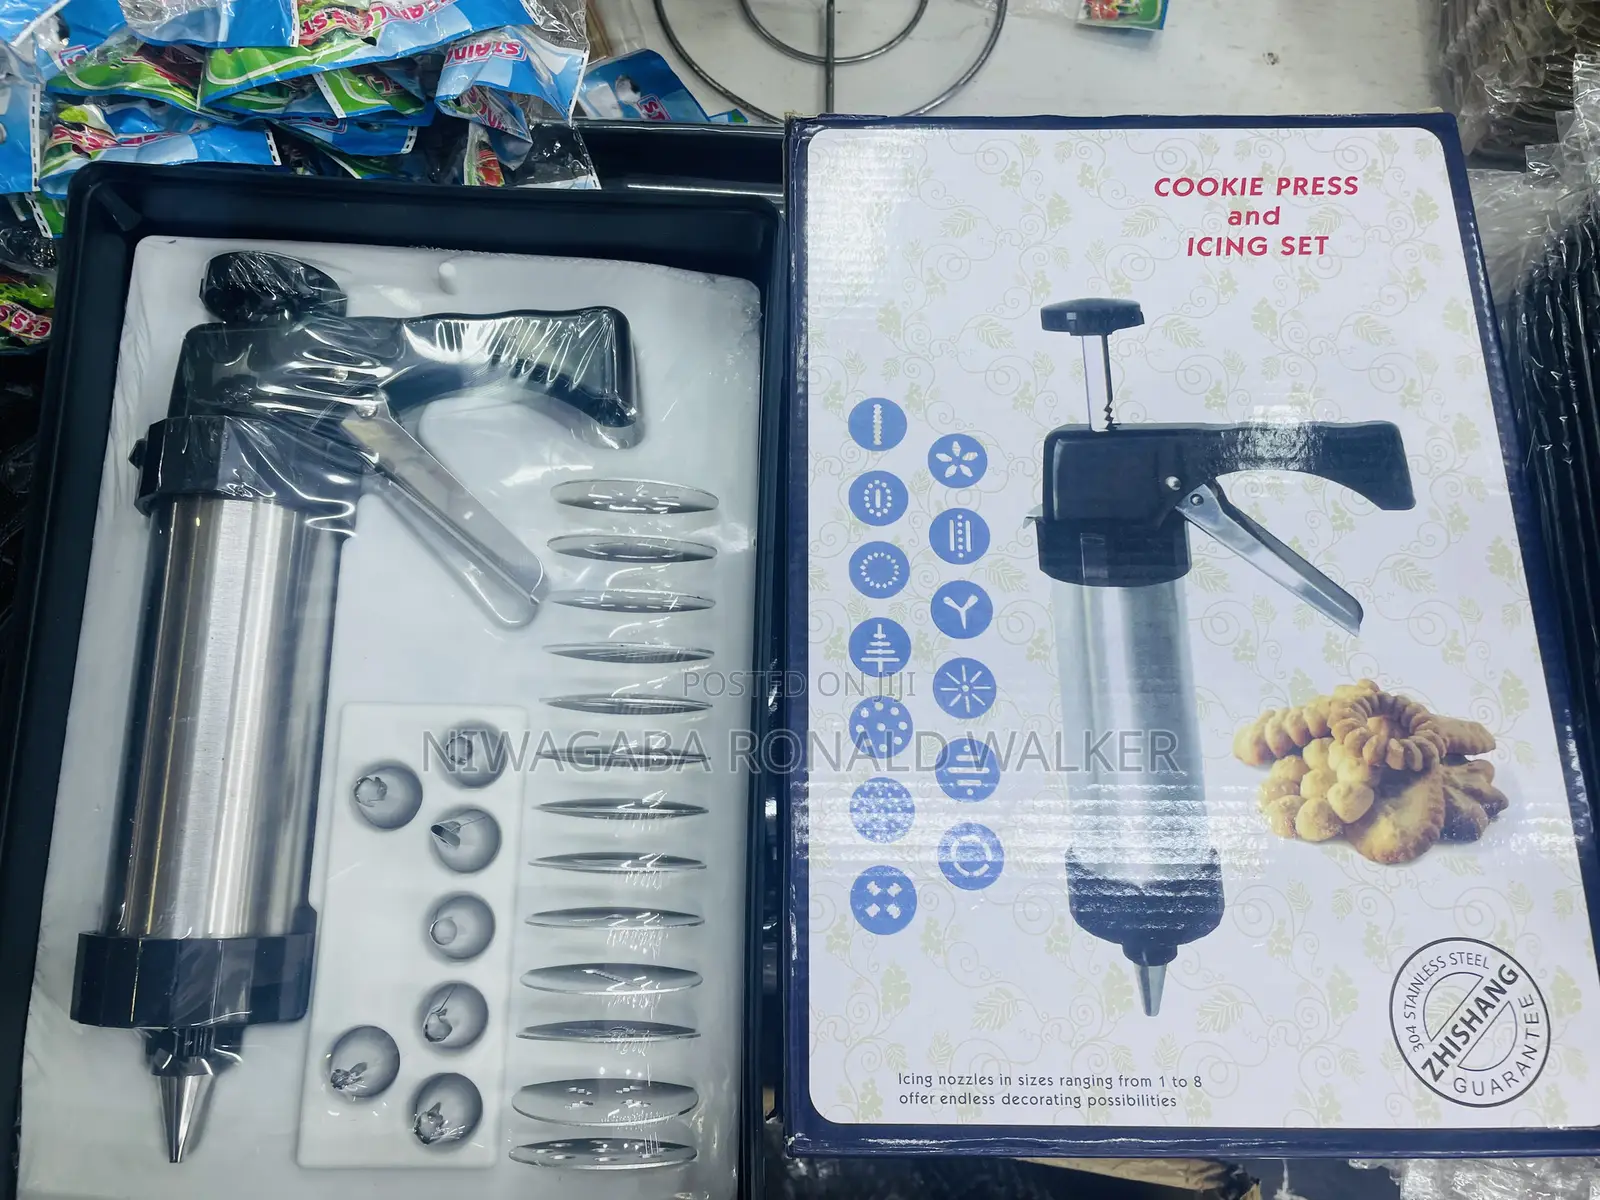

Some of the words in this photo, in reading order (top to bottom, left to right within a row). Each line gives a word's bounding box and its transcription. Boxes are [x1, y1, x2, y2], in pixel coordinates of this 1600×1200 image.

[1154, 177, 1264, 197] COOKIE
[1276, 176, 1359, 196] PRESS
[1228, 206, 1281, 226] and
[1187, 236, 1268, 257] ICING
[1281, 236, 1329, 256] SET
[1448, 951, 1490, 970] STEEL
[1403, 955, 1447, 1020] STAINLESS
[1420, 963, 1520, 1083] ZHISHANG
[1405, 1025, 1425, 1053] 304
[1453, 994, 1541, 1097] GUARANTEE
[898, 1073, 933, 1088] Icing
[938, 1073, 994, 1086] nozzles
[1000, 1073, 1012, 1086] in
[1018, 1073, 1054, 1087] sizes
[1059, 1075, 1113, 1090] ranging
[1118, 1075, 1152, 1088] from
[1158, 1075, 1165, 1088] 1
[1171, 1076, 1188, 1088] to
[1193, 1075, 1203, 1088] 8
[899, 1092, 934, 1105] offer
[939, 1092, 995, 1106] endless
[1001, 1093, 1082, 1109] decorating
[1087, 1093, 1177, 1109] possibilities
